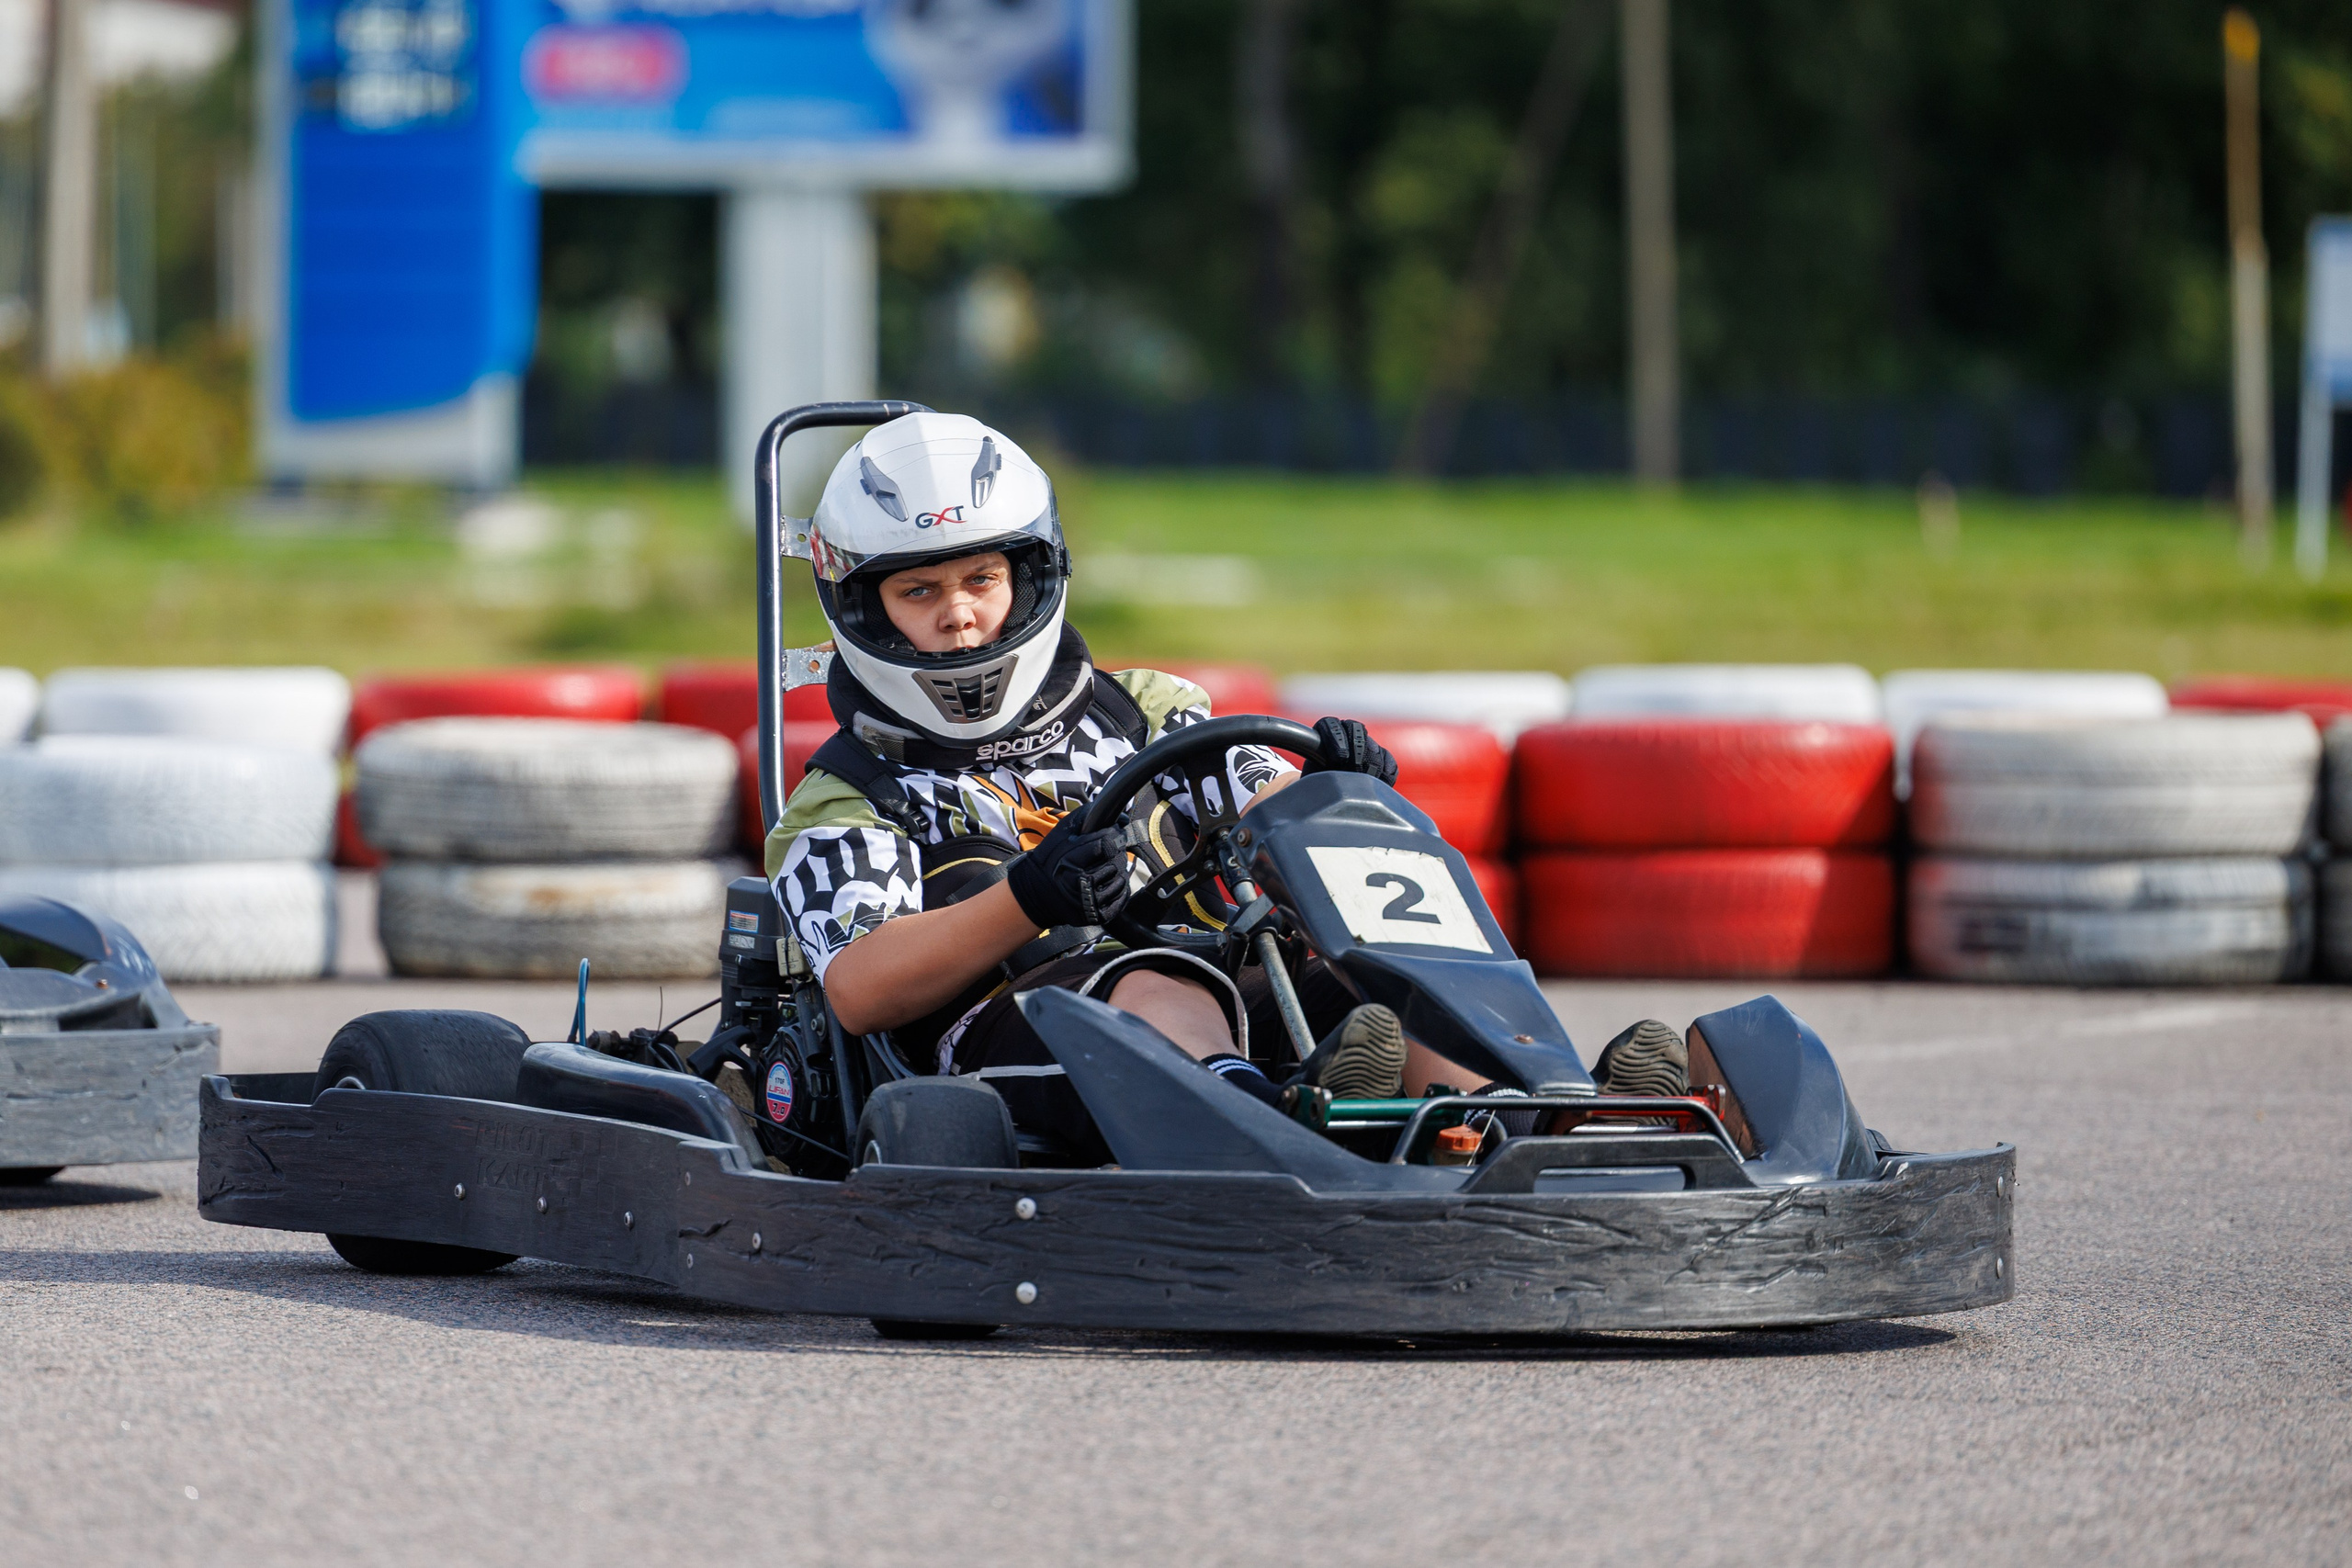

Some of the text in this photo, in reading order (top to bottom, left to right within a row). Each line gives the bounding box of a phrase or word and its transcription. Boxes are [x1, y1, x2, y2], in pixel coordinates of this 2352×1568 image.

[915, 505, 967, 529] GXT
[976, 720, 1064, 761] sparco
[1365, 872, 1442, 925] 2
[768, 1085, 790, 1096] LIFAN
[773, 1102, 786, 1115] 7.0
